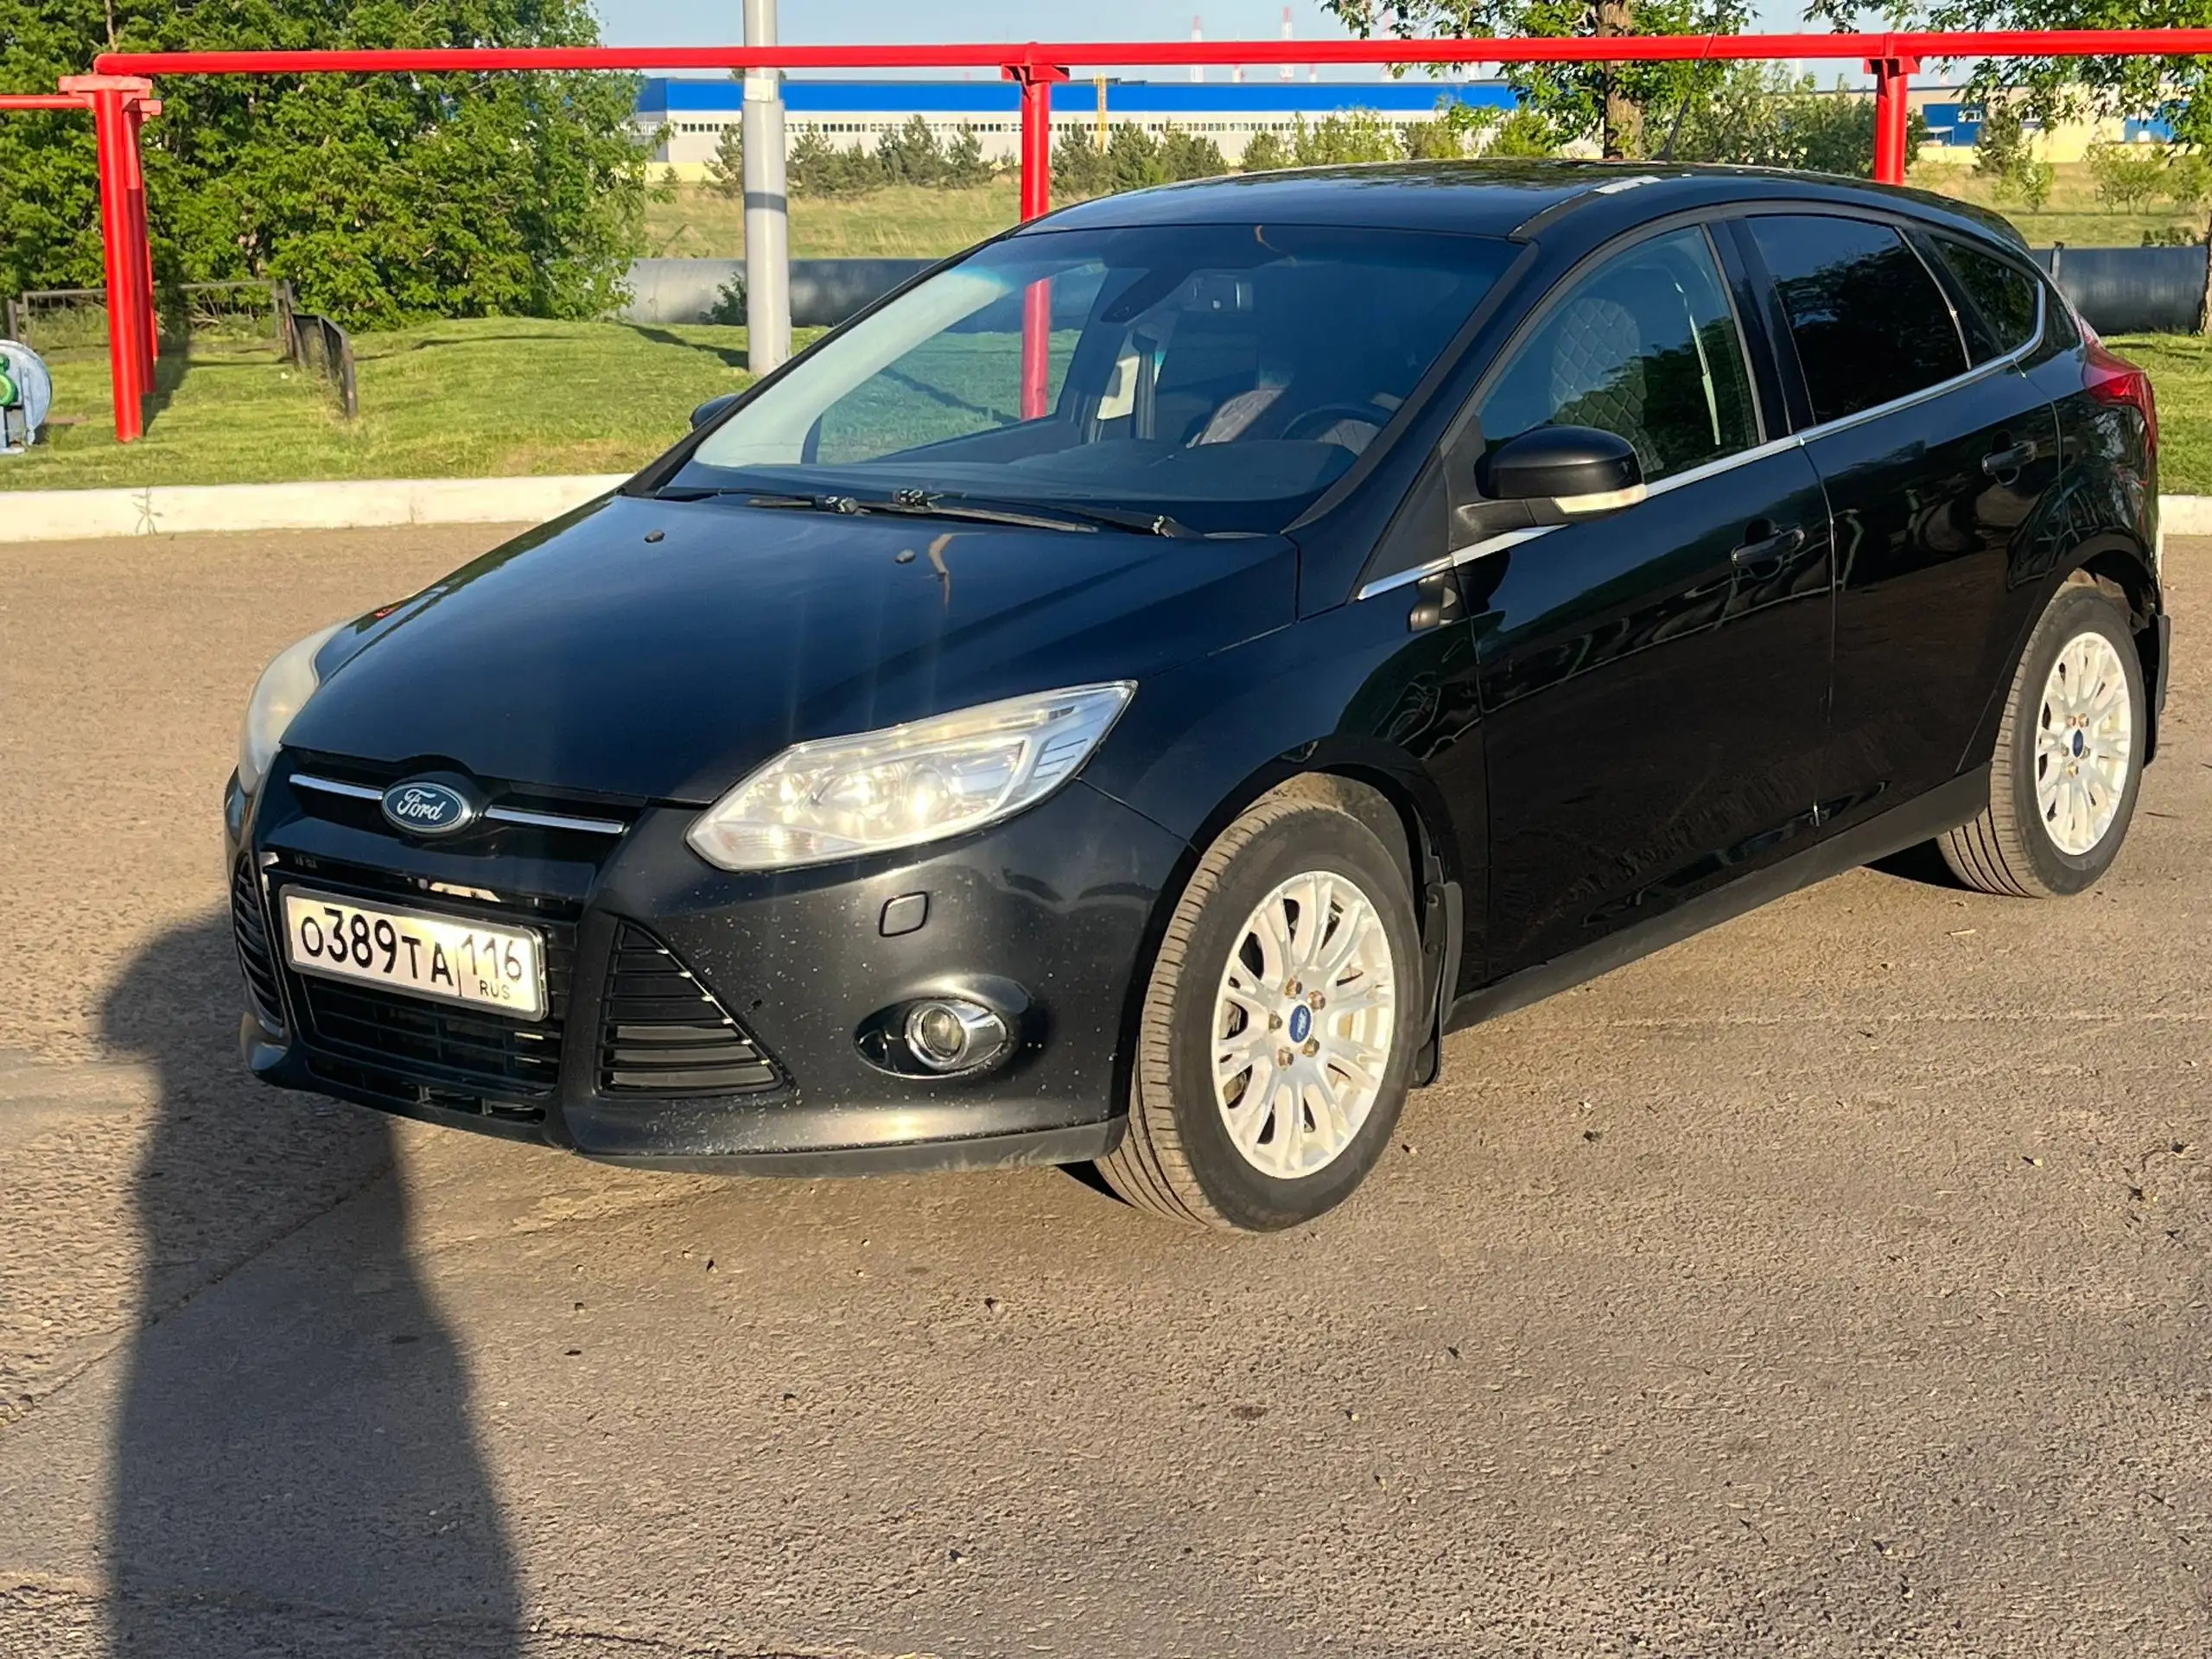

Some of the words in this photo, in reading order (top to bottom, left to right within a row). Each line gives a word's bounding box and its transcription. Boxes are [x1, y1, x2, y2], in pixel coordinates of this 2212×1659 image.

[397, 788, 447, 820] Ford
[461, 934, 522, 982] 116
[480, 979, 511, 1000] RUS
